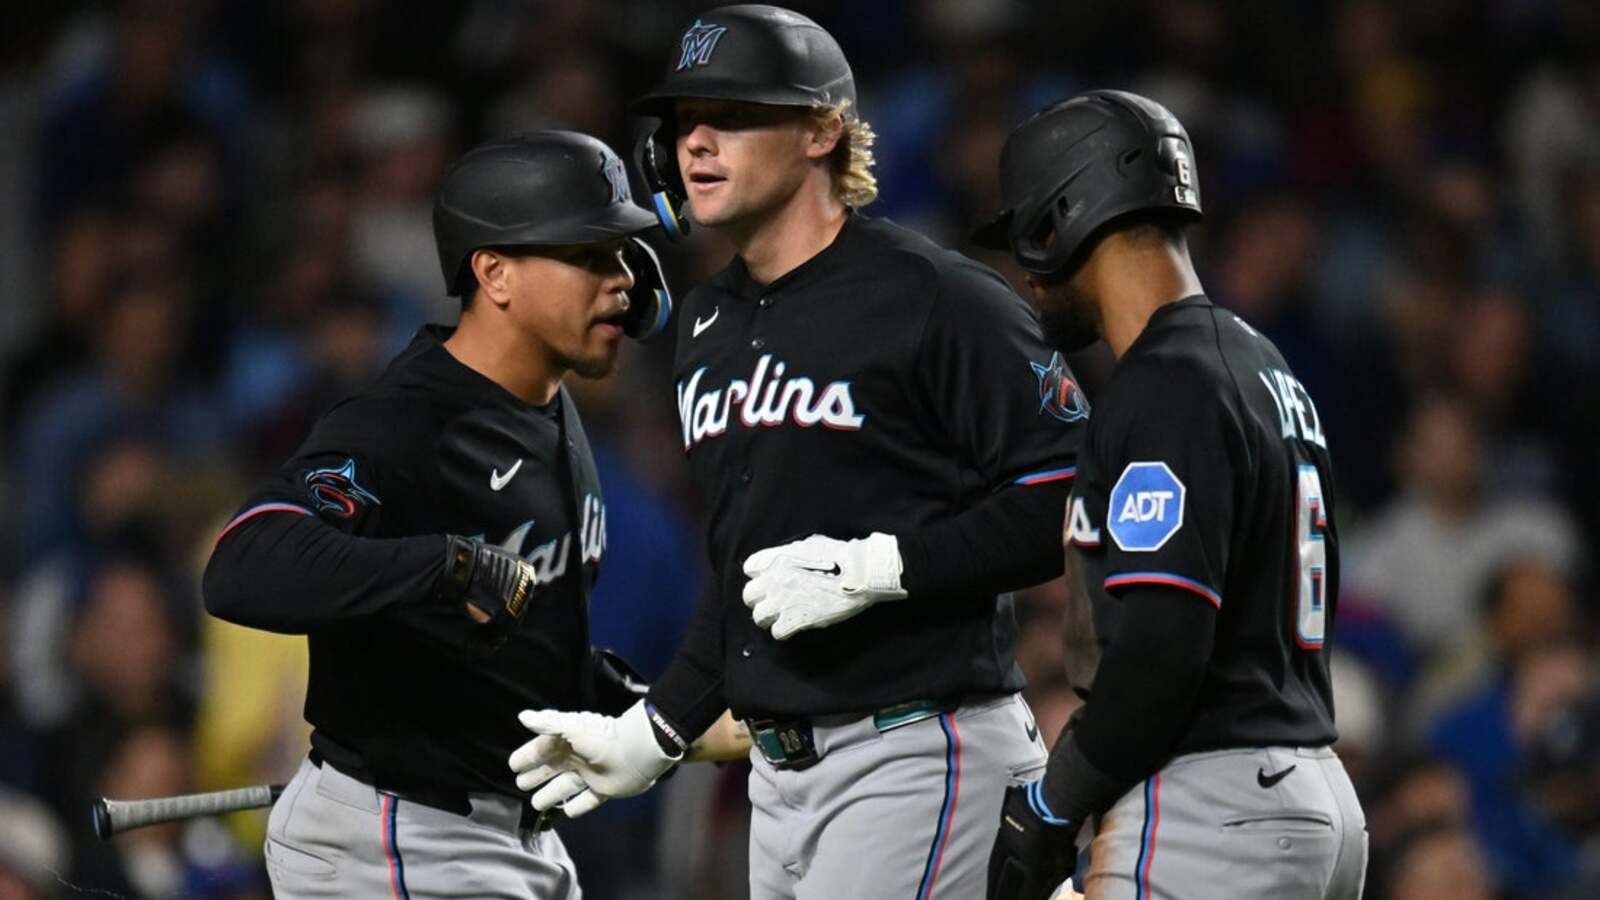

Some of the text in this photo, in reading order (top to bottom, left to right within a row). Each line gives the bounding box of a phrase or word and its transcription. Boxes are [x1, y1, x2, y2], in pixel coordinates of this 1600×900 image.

[1176, 159, 1191, 186] 6
[677, 353, 867, 452] Marlins
[1258, 368, 1327, 450] LPEZ
[1117, 490, 1175, 523] ADT
[1295, 463, 1328, 650] 6
